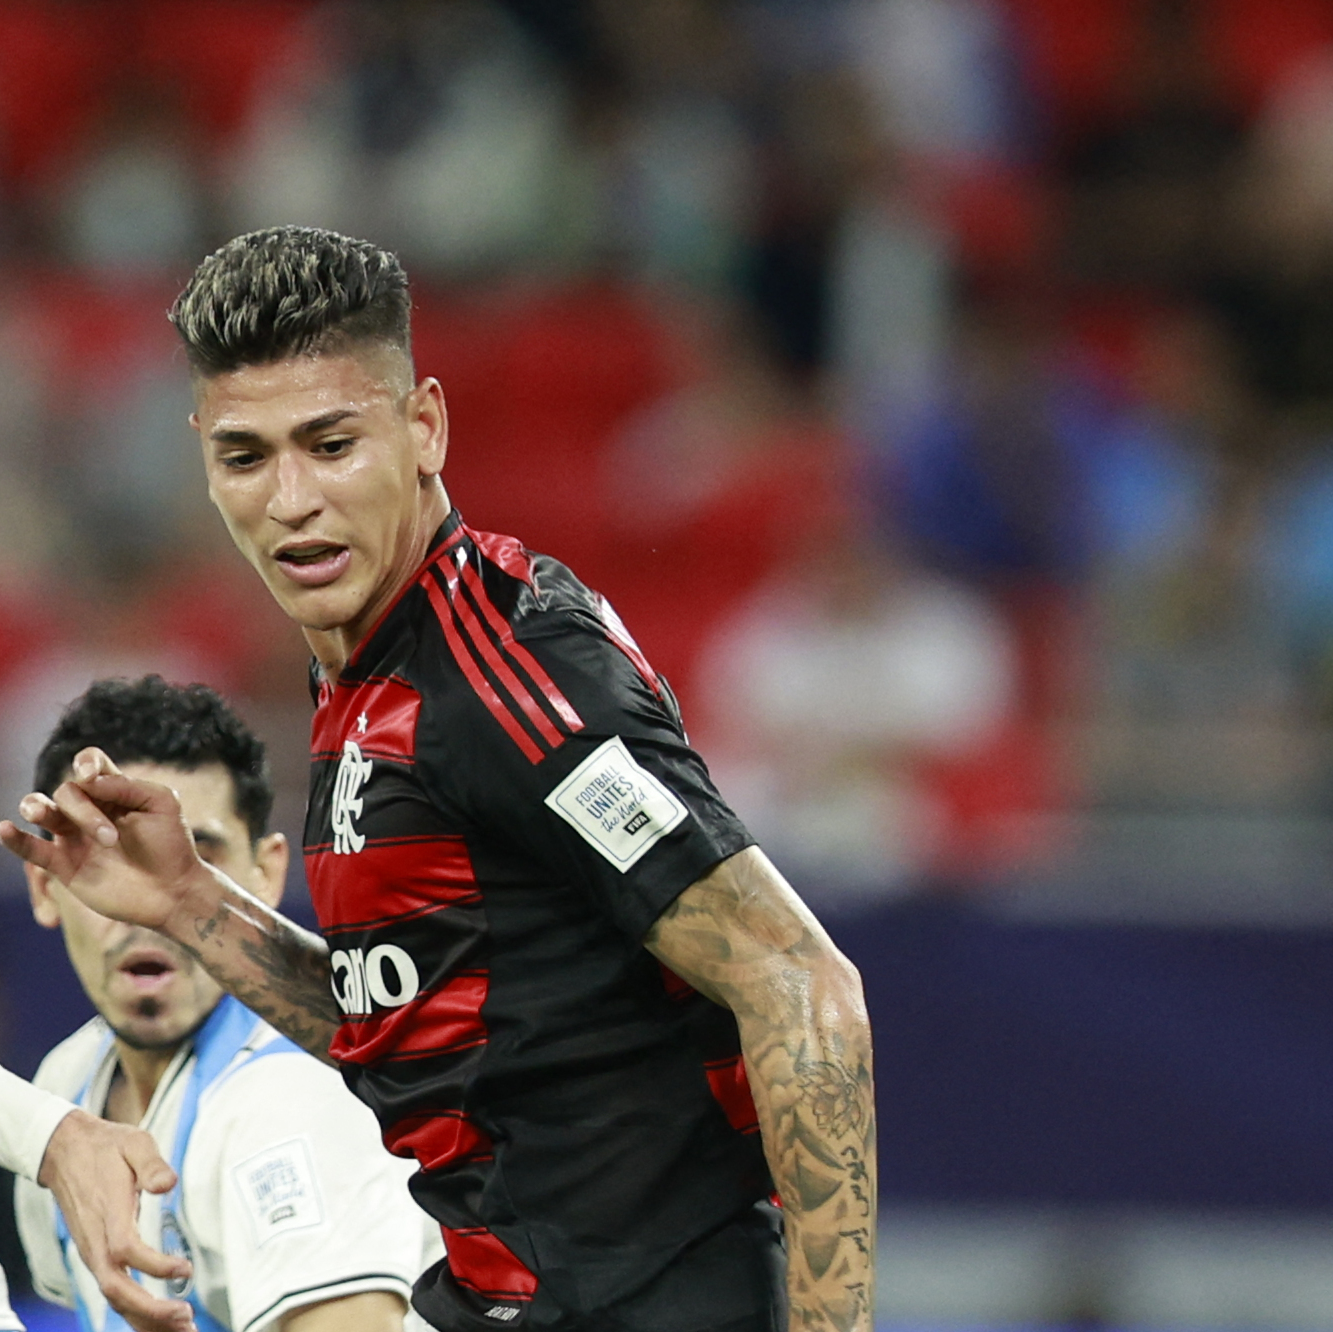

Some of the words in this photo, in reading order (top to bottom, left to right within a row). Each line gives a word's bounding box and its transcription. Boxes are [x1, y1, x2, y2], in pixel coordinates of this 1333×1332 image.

[575, 765, 620, 807] FOOTBALL
[586, 775, 633, 820] UNITES
[615, 786, 650, 820] World
[331, 943, 419, 1014] ano
